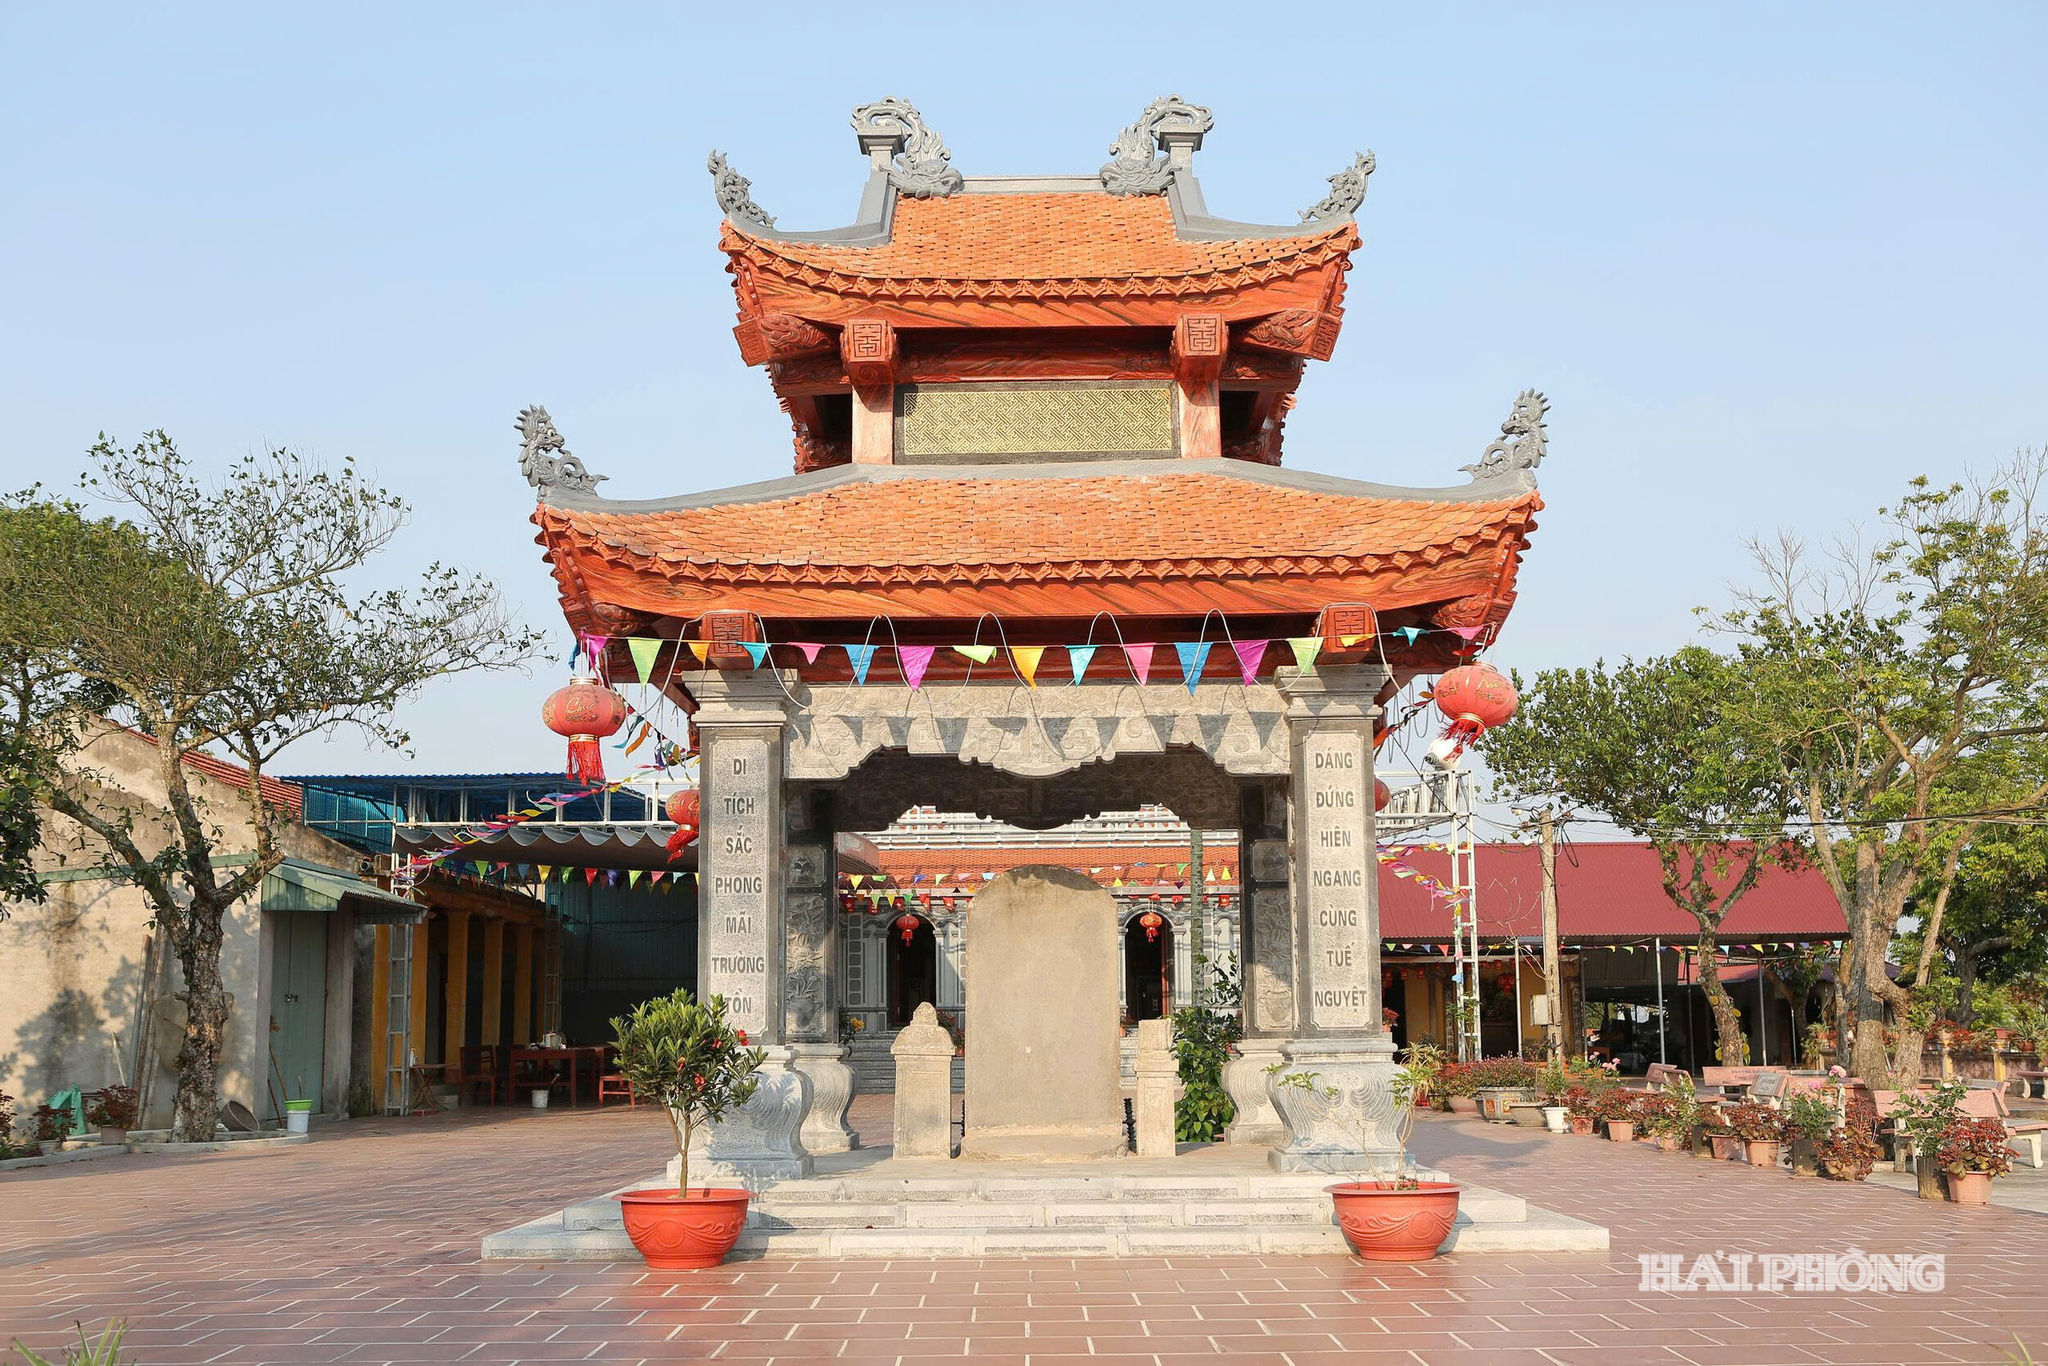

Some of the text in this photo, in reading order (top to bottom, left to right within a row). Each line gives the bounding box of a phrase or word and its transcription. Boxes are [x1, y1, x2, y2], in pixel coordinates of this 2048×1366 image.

[711, 759, 765, 1013] DI TÍCH SẮC PHONG MÃI TRƯỜNG TỒN
[1313, 747, 1367, 1012] DÁNG ĐỨNG HIÊN NGANG CÙNG TUẾ NGUYỆT
